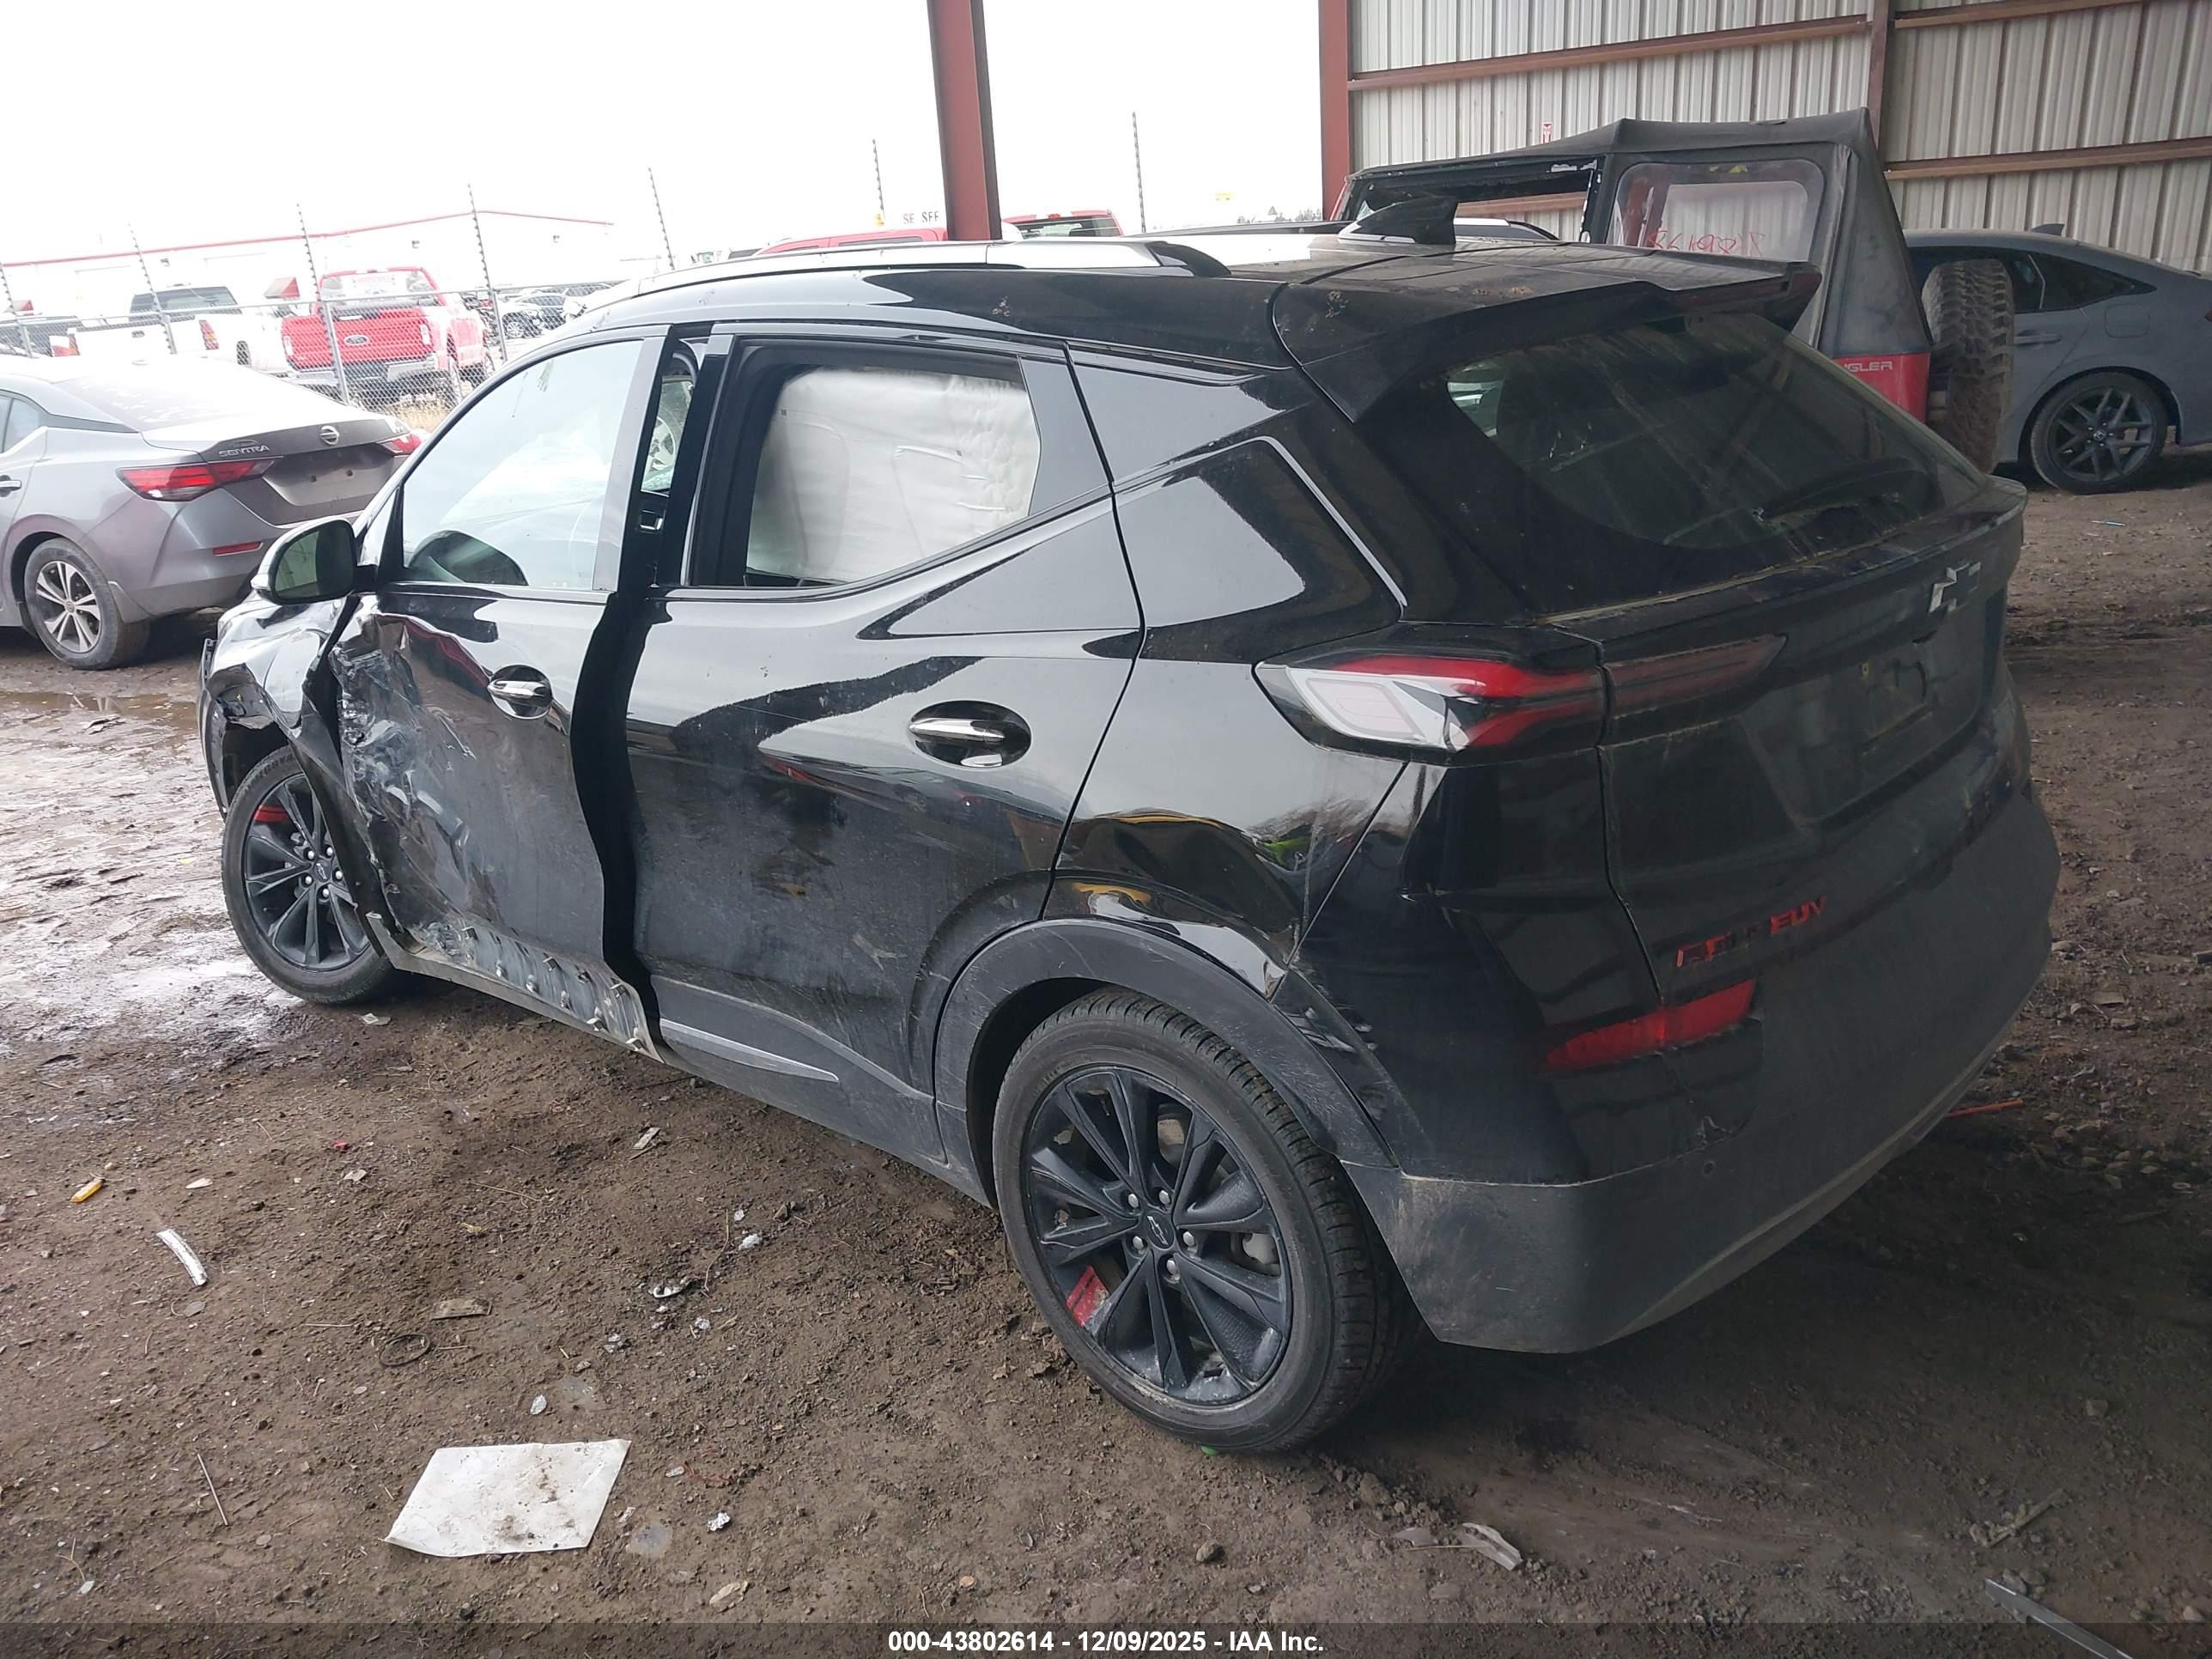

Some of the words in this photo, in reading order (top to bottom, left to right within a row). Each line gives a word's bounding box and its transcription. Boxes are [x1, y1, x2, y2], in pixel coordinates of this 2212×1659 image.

[1844, 361, 1893, 373] GLER
[218, 445, 270, 458] SENTRA
[1769, 894, 1826, 934] EUV
